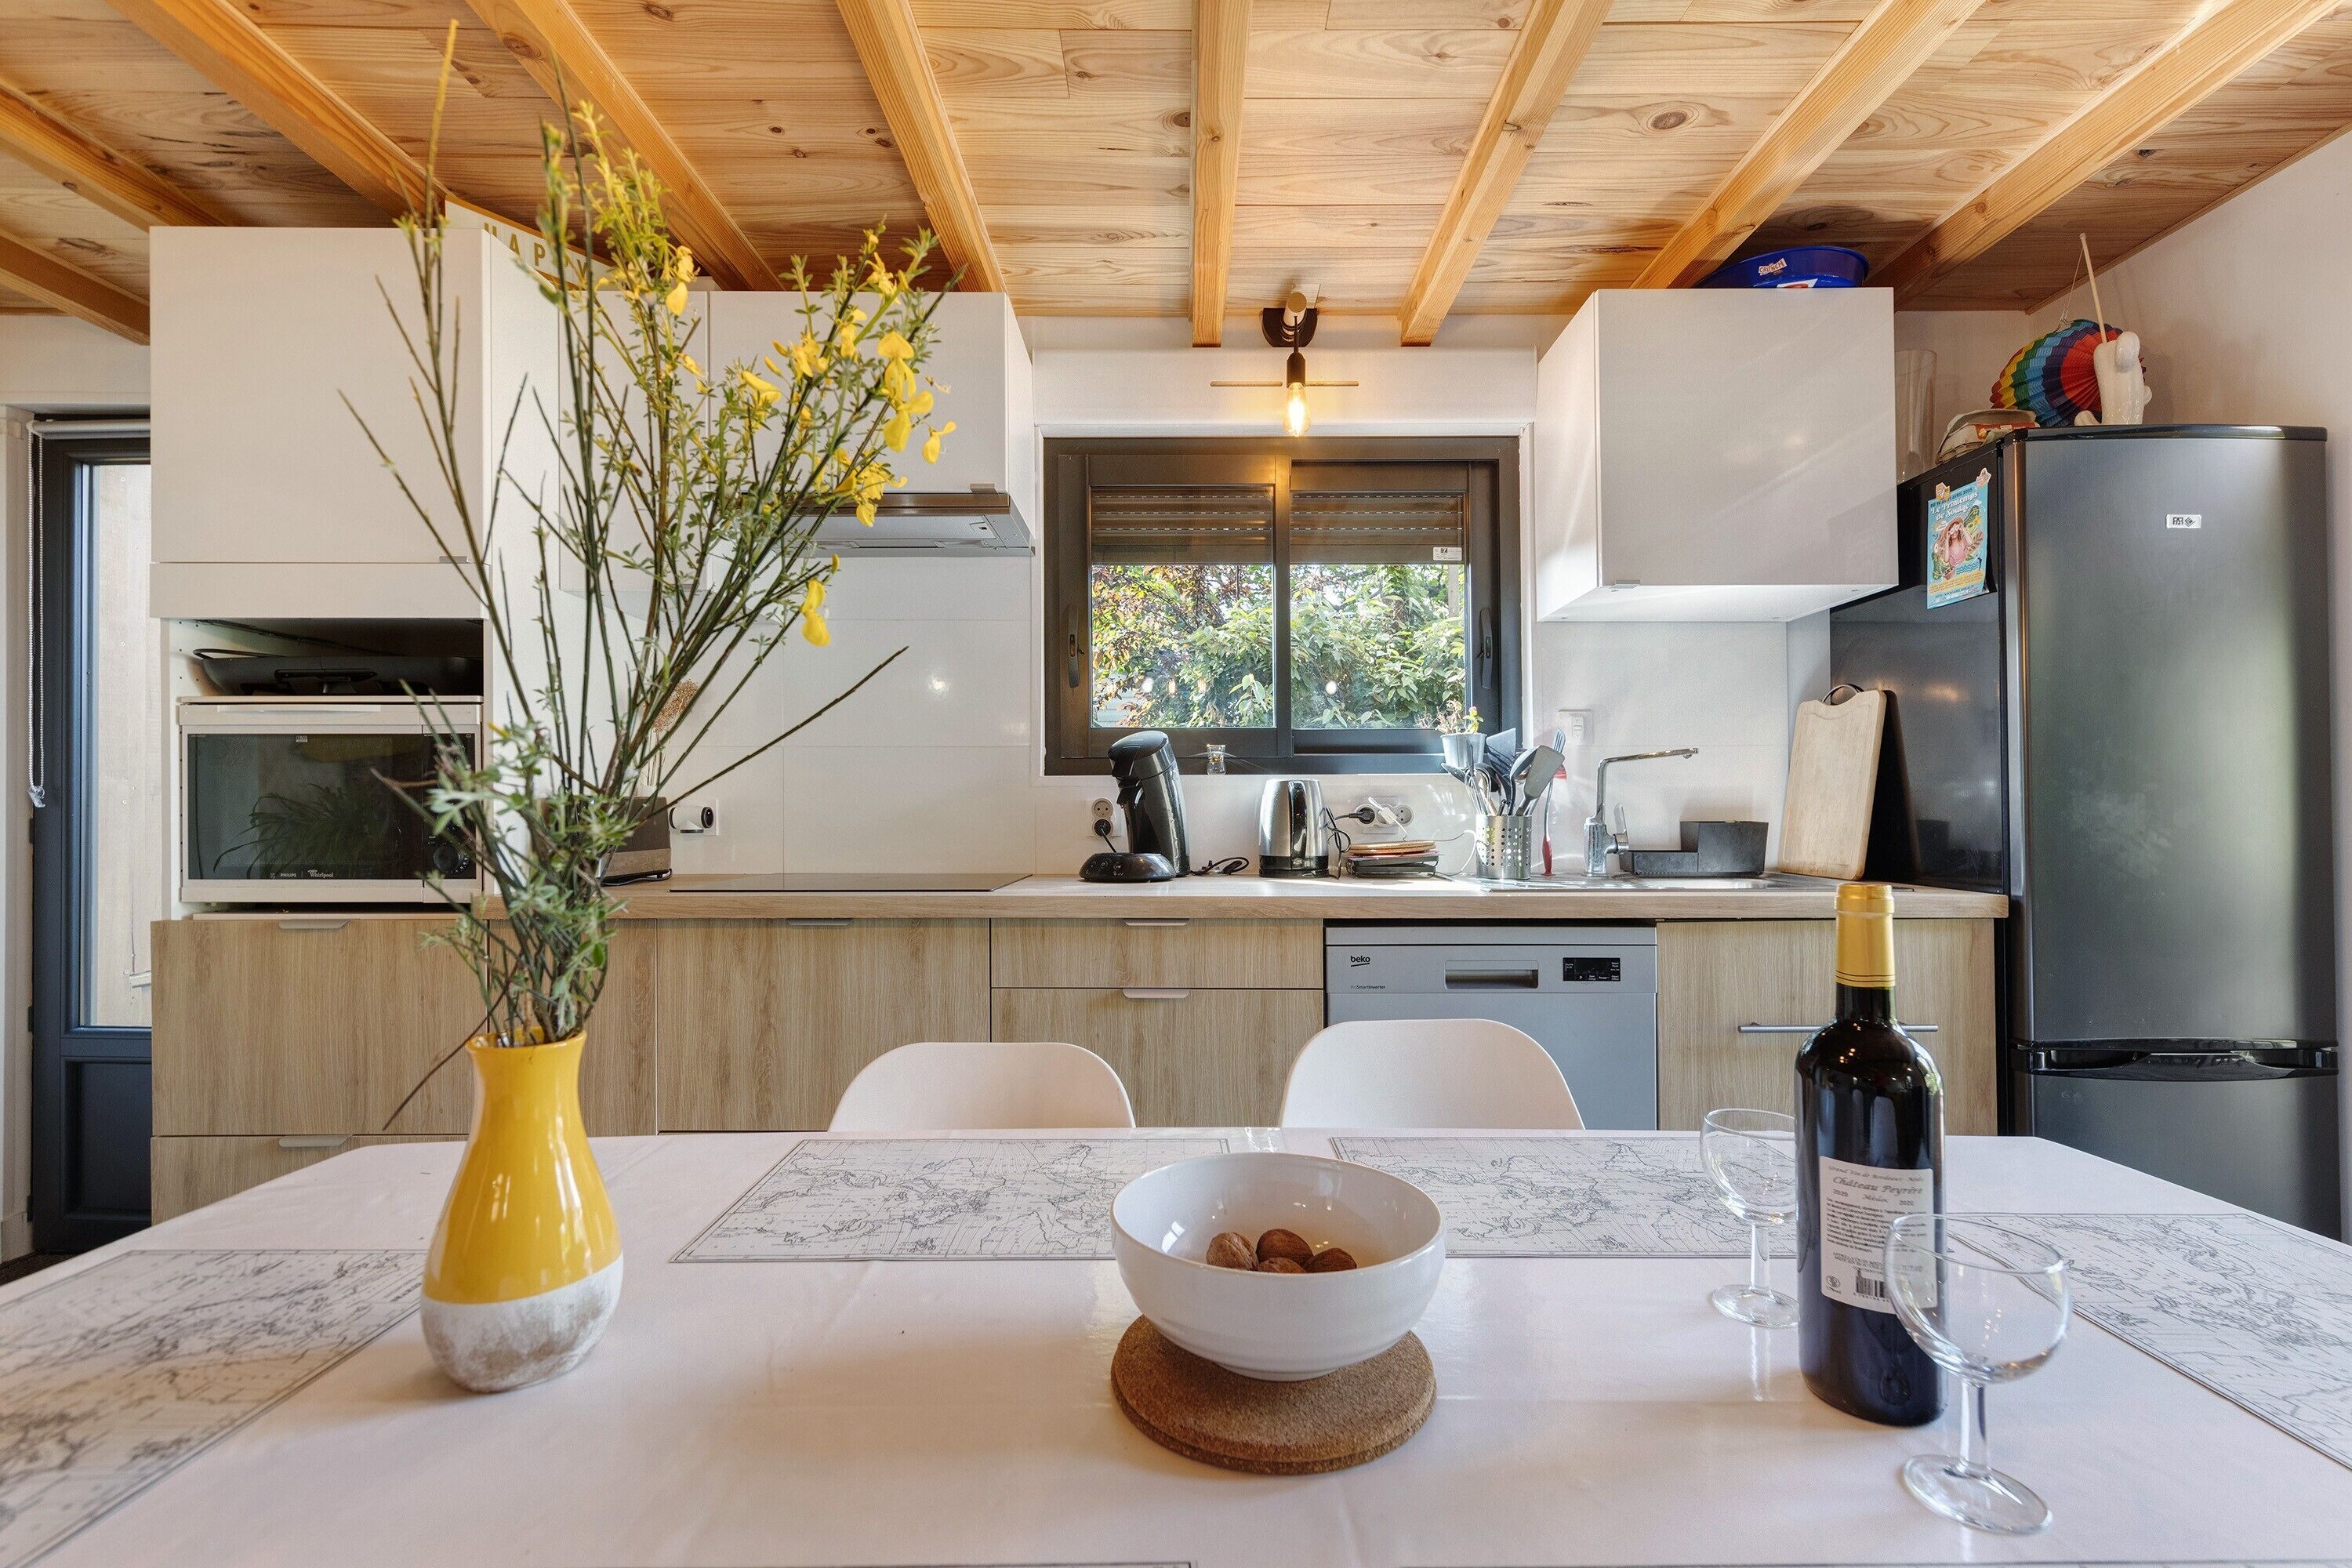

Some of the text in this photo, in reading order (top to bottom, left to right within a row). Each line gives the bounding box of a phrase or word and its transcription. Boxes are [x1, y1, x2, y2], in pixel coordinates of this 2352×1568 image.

[1759, 260, 1785, 273] CRUNCH
[1930, 492, 1980, 515] Le Printemps
[1936, 512, 1945, 521] de
[307, 869, 334, 879] Whirlpool
[1832, 1176, 1878, 1192] Château
[1833, 1189, 1849, 1197] 2020
